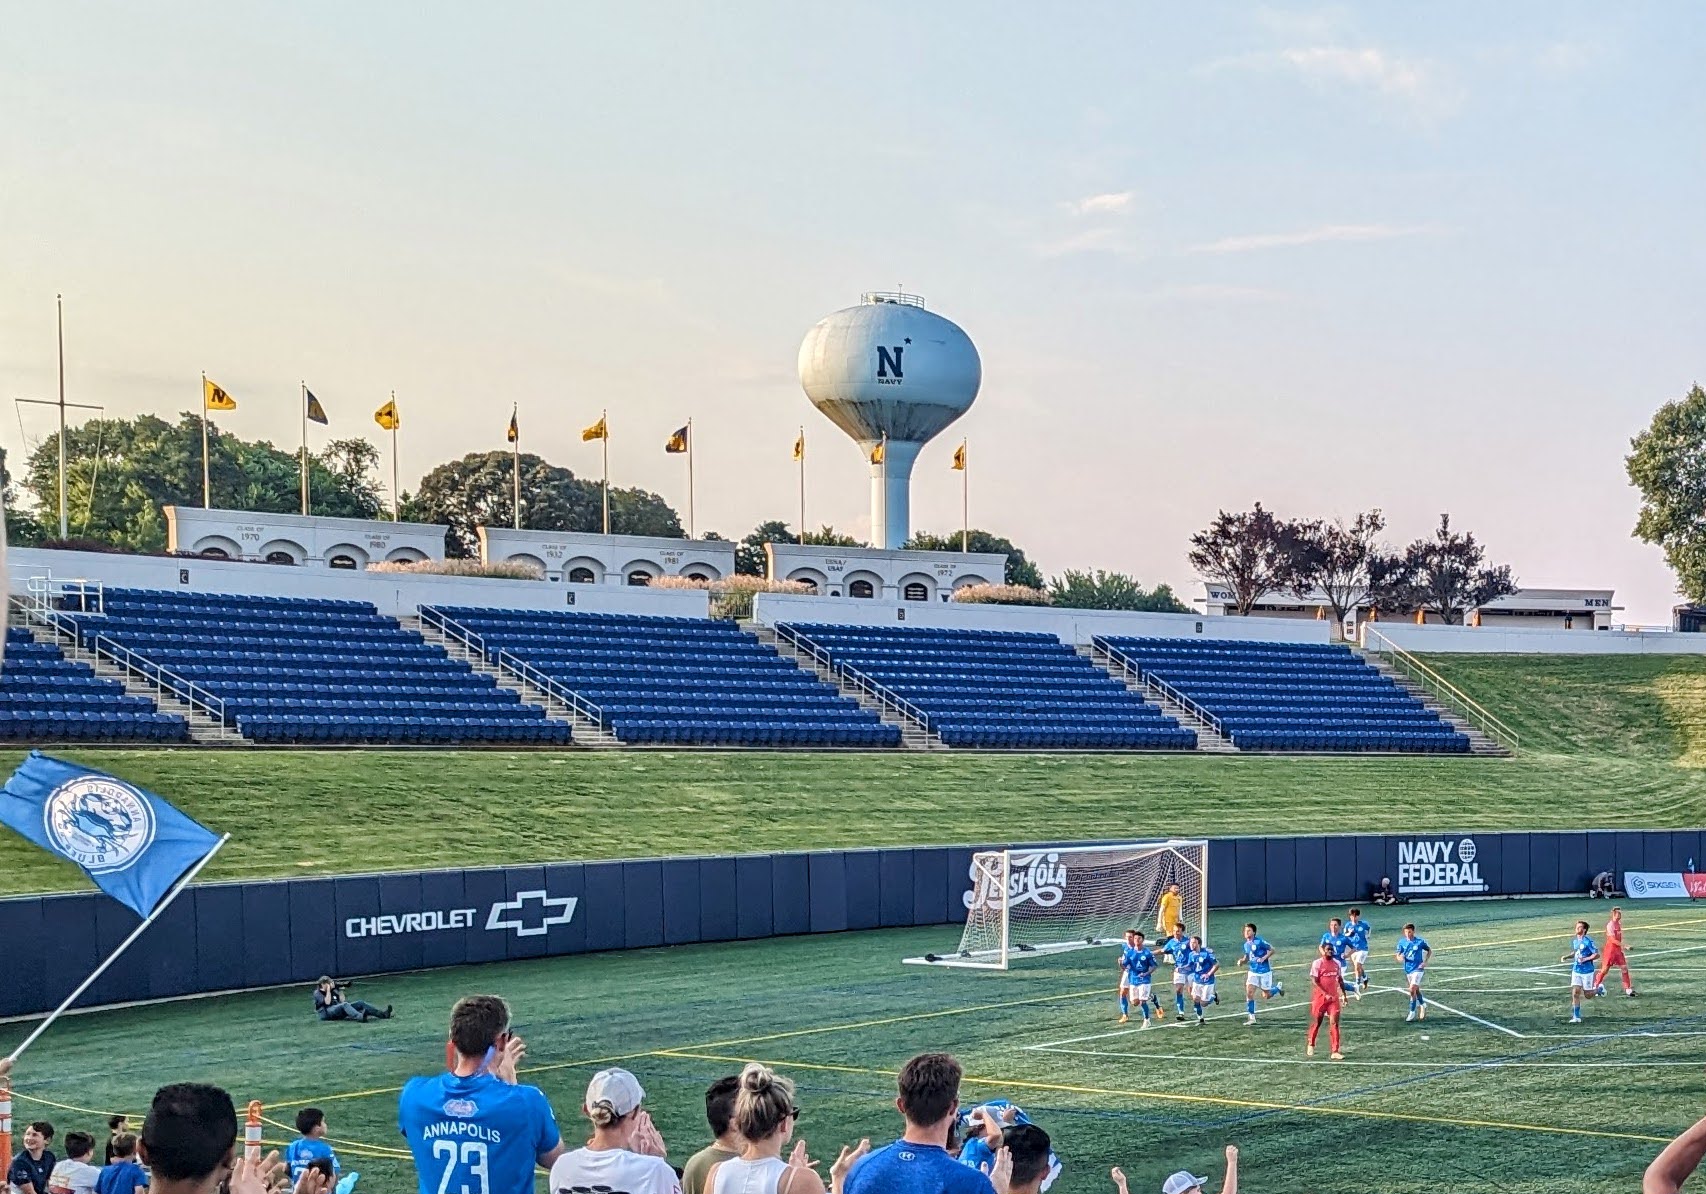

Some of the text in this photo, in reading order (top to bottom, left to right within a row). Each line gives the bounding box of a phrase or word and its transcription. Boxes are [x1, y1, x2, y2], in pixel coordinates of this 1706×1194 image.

[877, 346, 904, 378] N
[1584, 598, 1610, 607] MEN
[1398, 841, 1454, 864] NAVY
[1398, 863, 1484, 886] FEDERAL
[1646, 881, 1681, 889] SIXGEN
[345, 908, 476, 938] CHEVROLET
[423, 1121, 501, 1143] ANNAPOLIS
